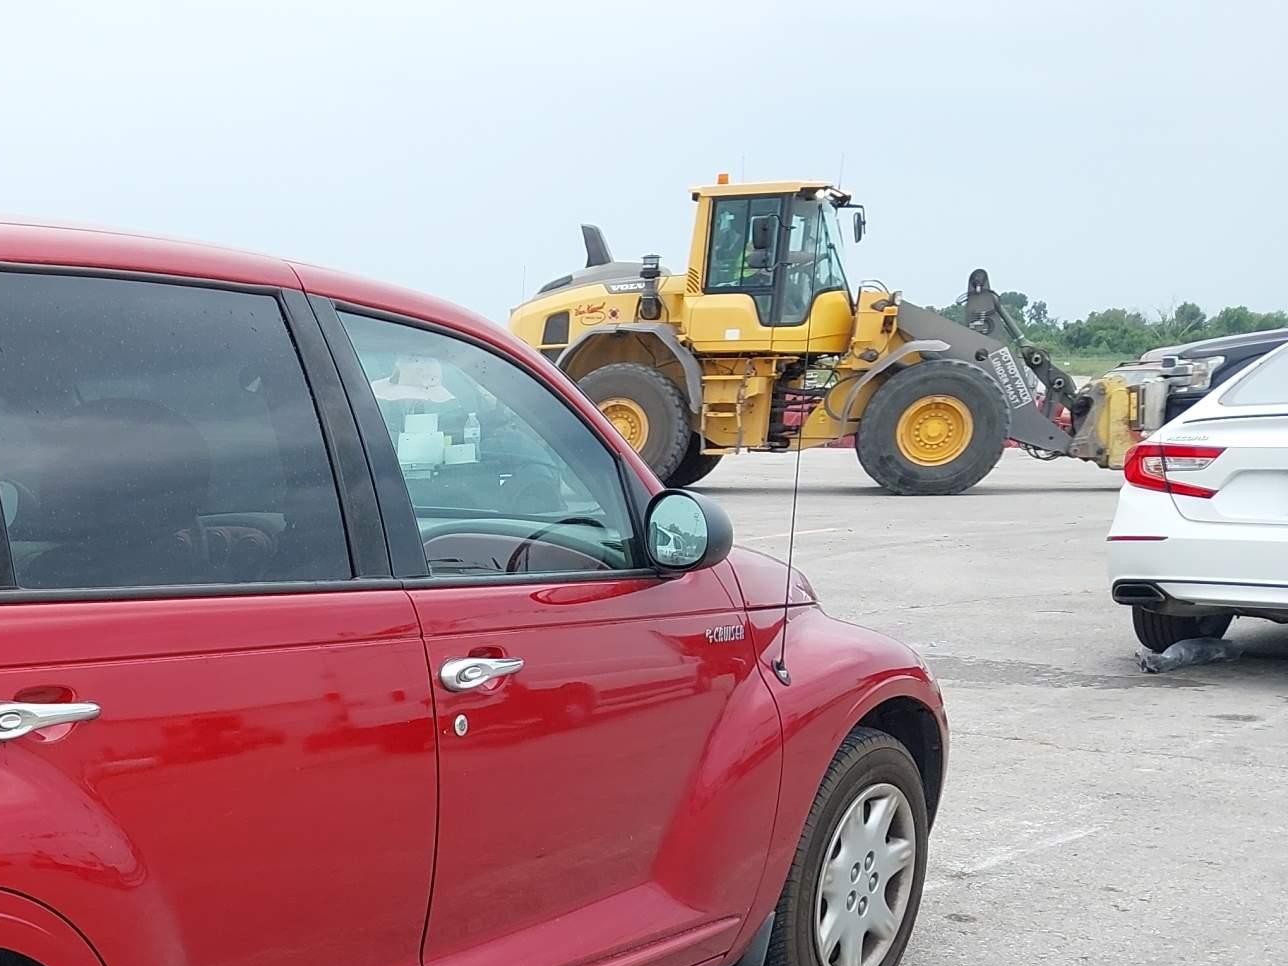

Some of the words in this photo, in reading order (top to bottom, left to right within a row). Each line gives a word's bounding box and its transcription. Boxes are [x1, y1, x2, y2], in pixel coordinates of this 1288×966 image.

[992, 357, 1009, 385] UNDER
[1005, 383, 1020, 404] MAST
[1004, 360, 1019, 379] NOT
[1013, 377, 1030, 402] WALK
[713, 624, 745, 642] CRUISER
